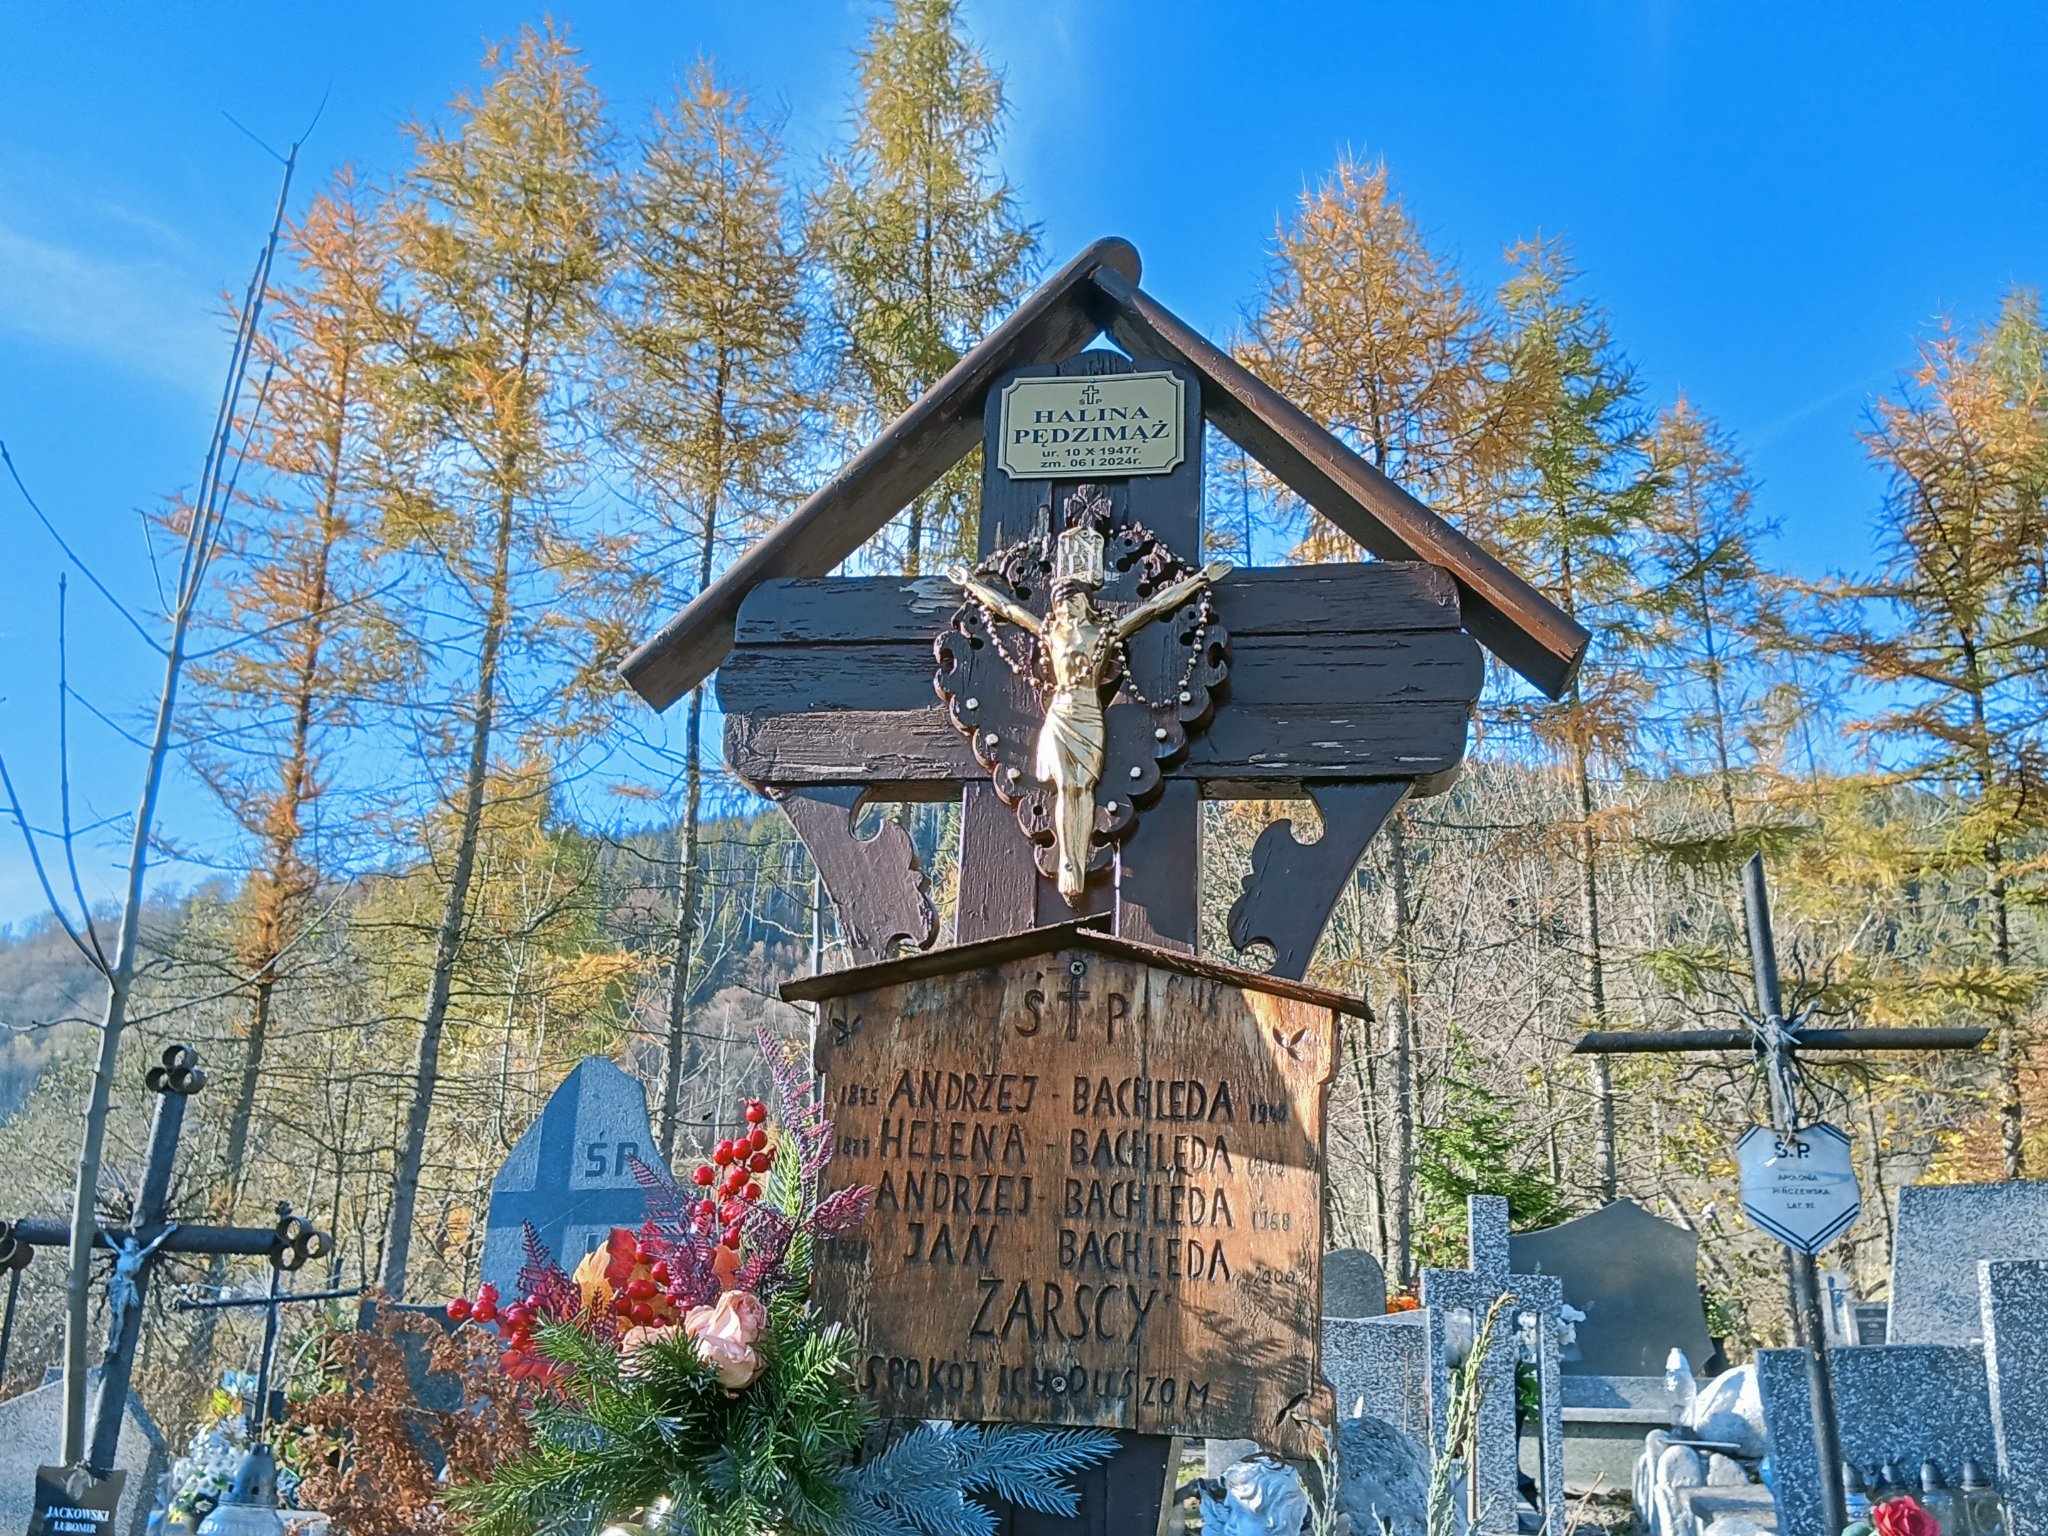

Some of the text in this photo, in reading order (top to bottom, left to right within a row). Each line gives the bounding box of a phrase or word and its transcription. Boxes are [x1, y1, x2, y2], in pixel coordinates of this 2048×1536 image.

[1012, 420, 1170, 447] PĘDZIMĄŻ
[1033, 406, 1150, 424] HALINA
[1040, 460, 1066, 468] zm.
[1070, 459, 1086, 467] 06
[1099, 457, 1142, 466] 2024r.
[1042, 446, 1142, 458] ur. 10 X 1947r.
[1107, 992, 1130, 1044] P
[888, 1069, 1039, 1113] ANDRZEJ
[1073, 1076, 1235, 1122] BACHLEDA
[880, 1116, 1026, 1164] HELENA
[1070, 1129, 1233, 1175] BACHLEDA
[876, 1170, 1033, 1217] ANDRZEJ
[1065, 1179, 1235, 1228] BACHLEDA
[907, 1222, 997, 1266] JAN
[1059, 1229, 1231, 1282] BACHLEDA
[968, 1278, 1159, 1346] ZARSCY
[45, 1506, 110, 1522] JACKOWSKI
